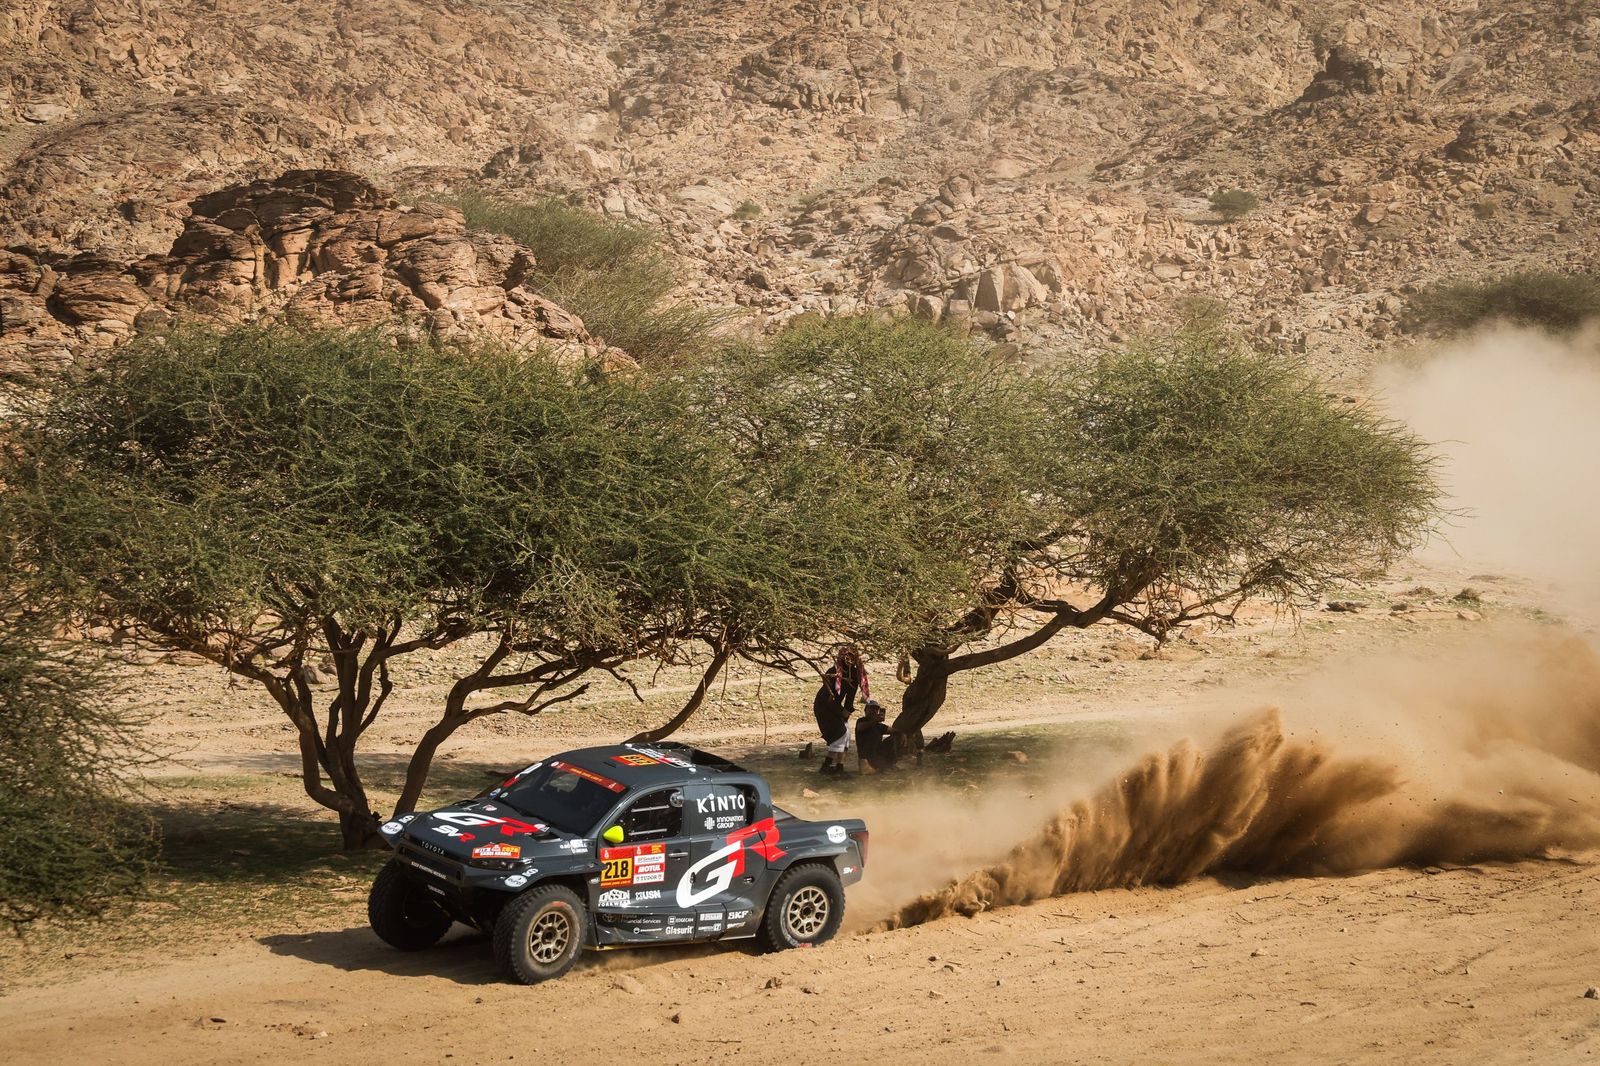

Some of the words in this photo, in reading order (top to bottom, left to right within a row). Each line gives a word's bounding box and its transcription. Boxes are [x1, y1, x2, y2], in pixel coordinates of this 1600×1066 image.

[433, 812, 539, 837] GR
[420, 840, 446, 856] TOYOTA
[676, 818, 788, 908] GR
[604, 860, 628, 880] 218
[637, 864, 661, 874] MOTUL
[640, 874, 658, 882] TUDOR
[642, 890, 662, 900] USN
[728, 910, 749, 920] SKF
[665, 925, 694, 935] Glasurit
